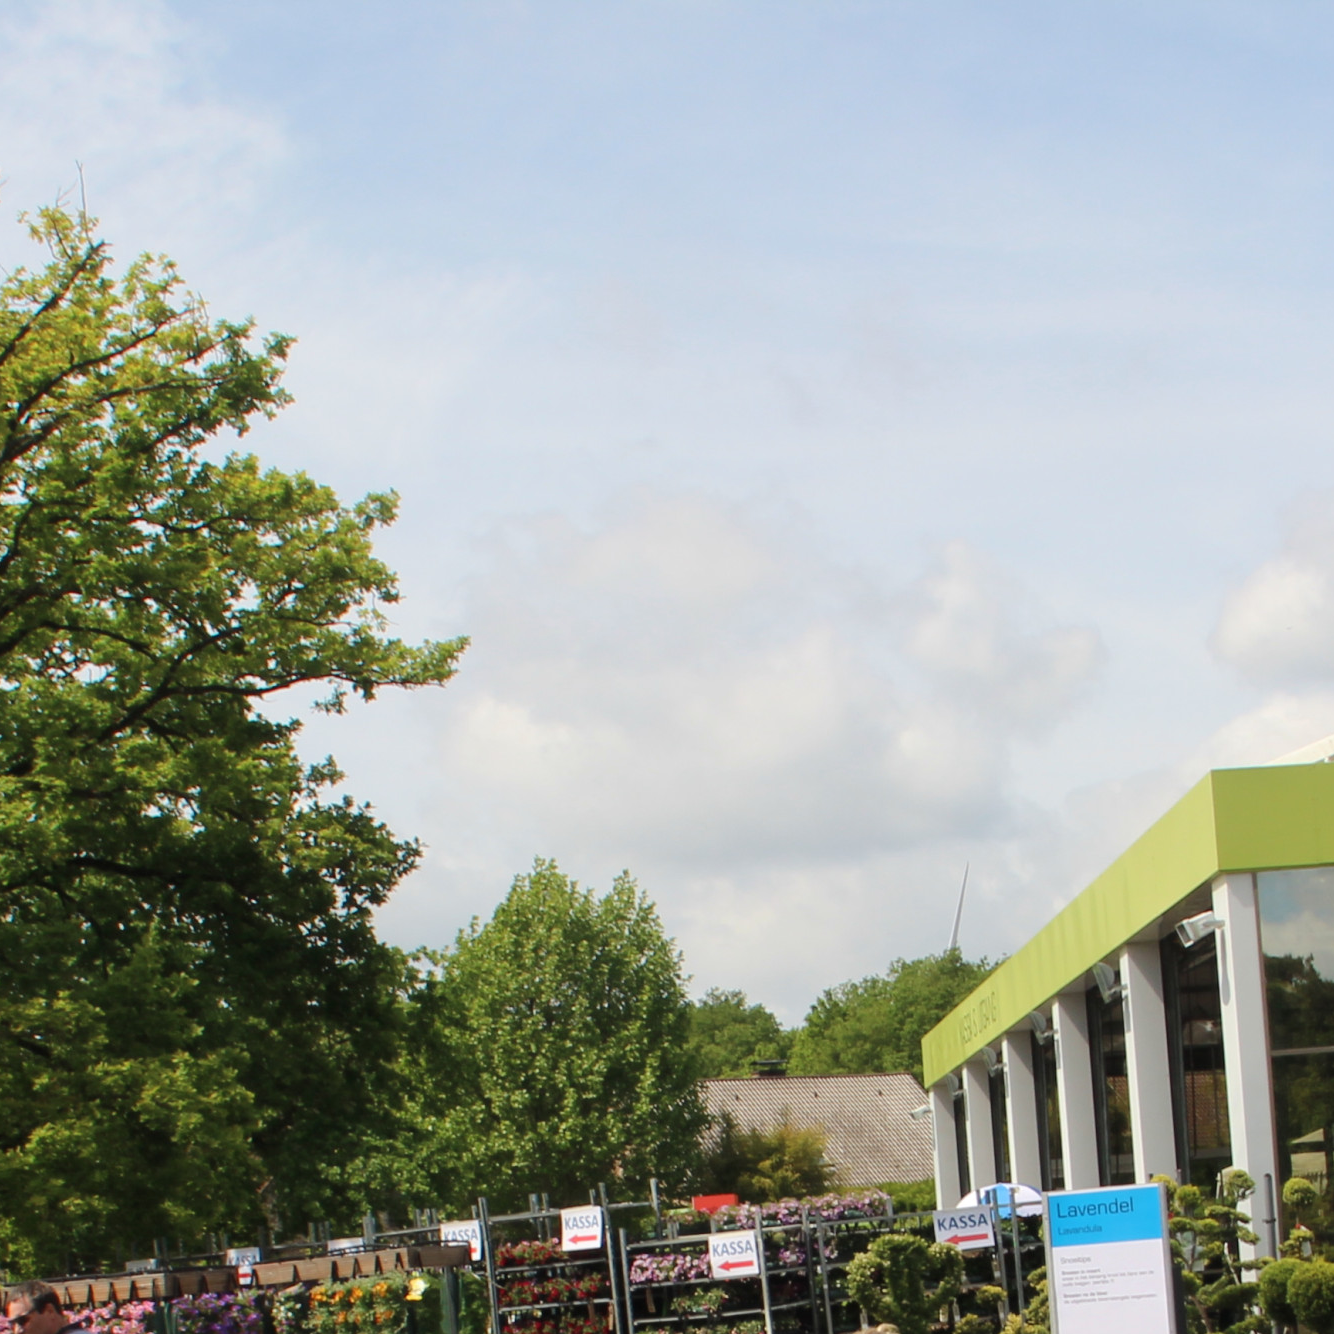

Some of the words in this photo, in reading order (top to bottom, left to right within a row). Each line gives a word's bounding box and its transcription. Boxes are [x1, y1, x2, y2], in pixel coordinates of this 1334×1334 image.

[1056, 1196, 1134, 1219] Lavendel
[564, 1214, 599, 1231] KASSA
[937, 1213, 989, 1232] KASSA
[1057, 1224, 1103, 1236] Lavandula
[712, 1240, 754, 1257] KASSA
